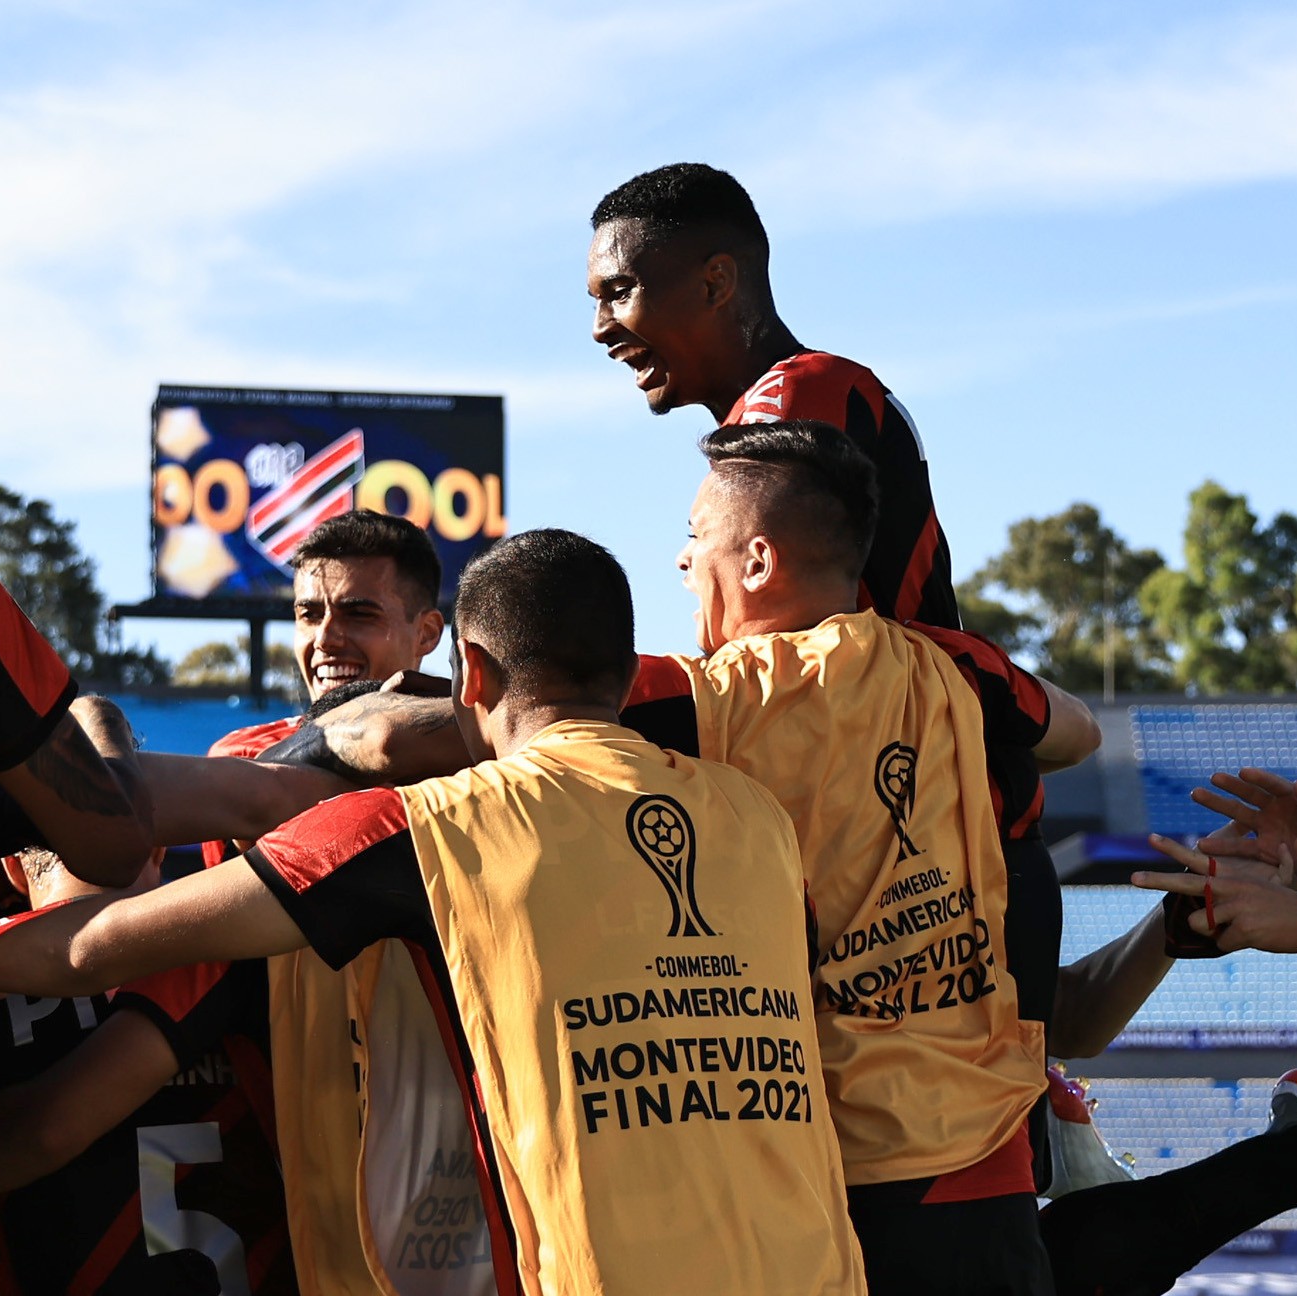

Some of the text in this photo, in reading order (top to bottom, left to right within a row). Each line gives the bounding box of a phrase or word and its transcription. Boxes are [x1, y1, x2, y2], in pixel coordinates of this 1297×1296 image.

[563, 986, 800, 1030] SUDAMERICANA
[571, 1036, 805, 1086] MONTEVIDEO
[581, 1078, 812, 1134] FINAL 2021
